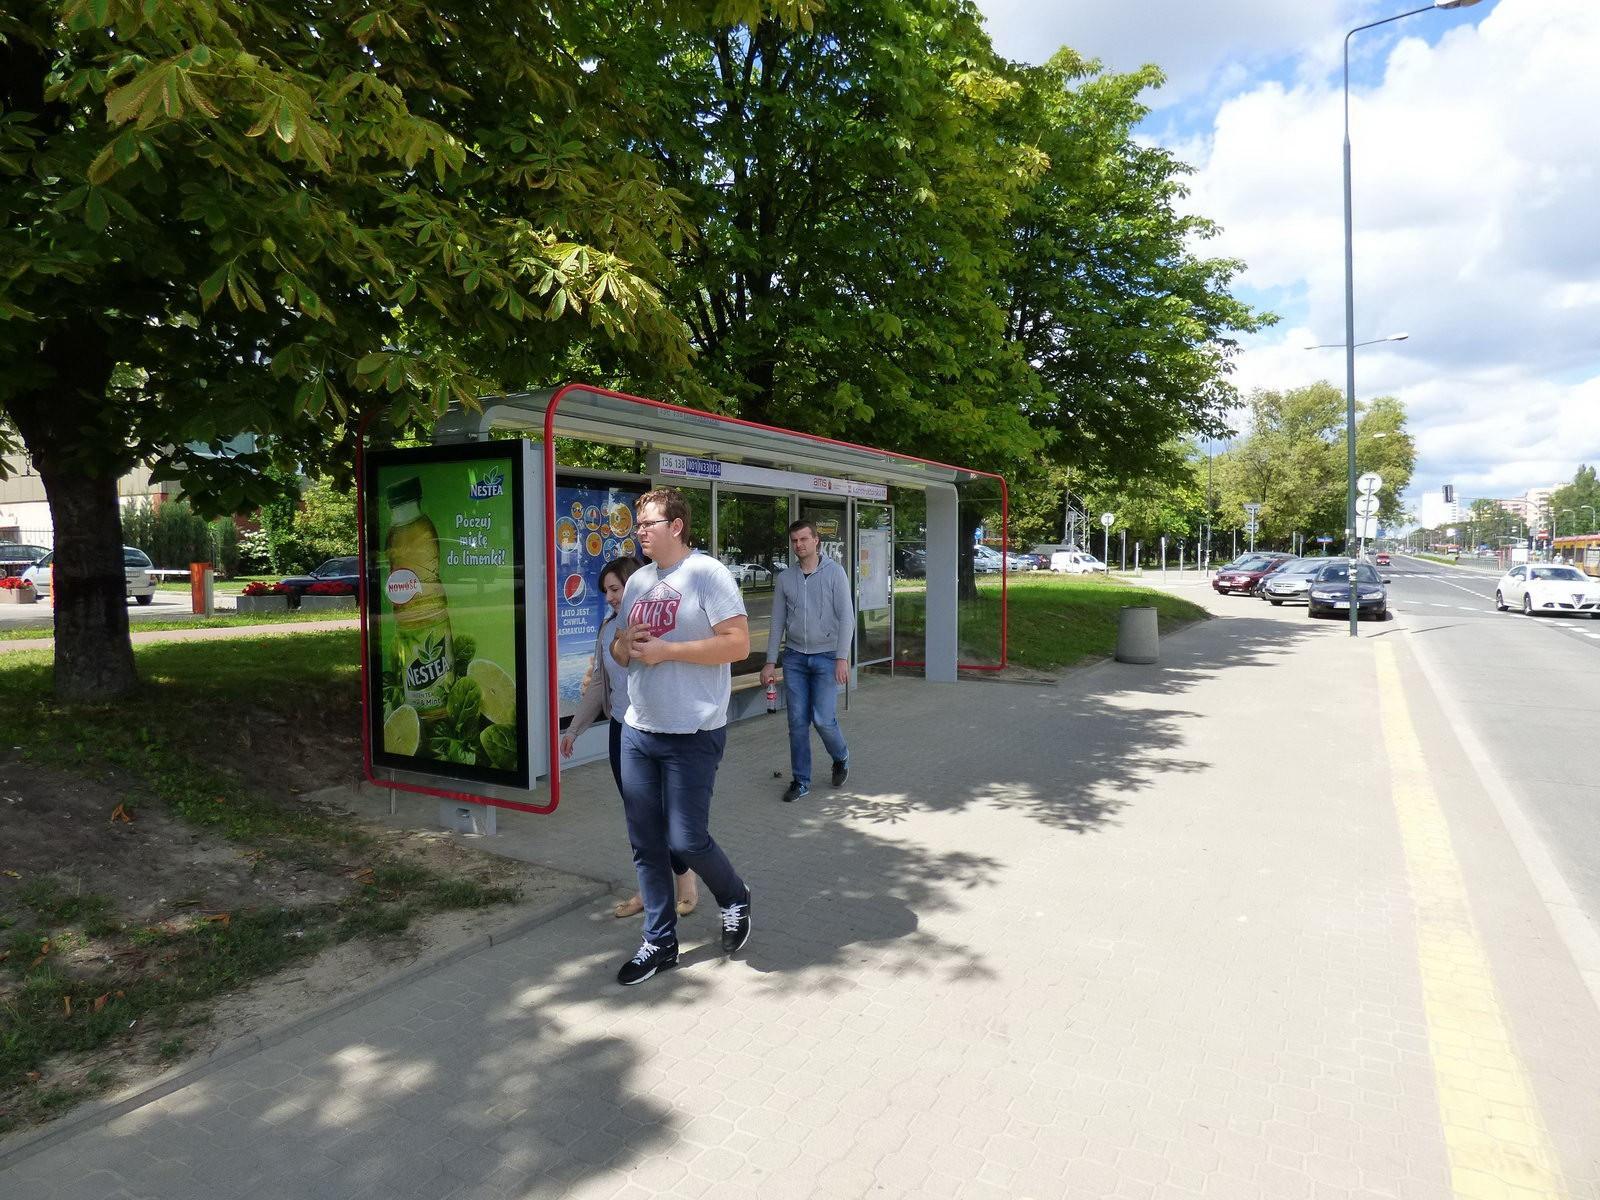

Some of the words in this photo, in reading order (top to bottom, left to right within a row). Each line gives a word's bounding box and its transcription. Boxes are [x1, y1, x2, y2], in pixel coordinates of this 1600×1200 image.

[661, 457, 673, 468] 136
[674, 459, 686, 469] 138
[471, 484, 504, 497] NESTEA
[456, 512, 492, 529] Poczuj
[447, 550, 459, 565] do
[463, 548, 506, 566] limonki!
[819, 541, 845, 560] KFC
[561, 609, 576, 617] LATO
[576, 608, 590, 616] JEST
[557, 626, 586, 636] ASMAKUJ
[407, 656, 450, 687] NESTEA
